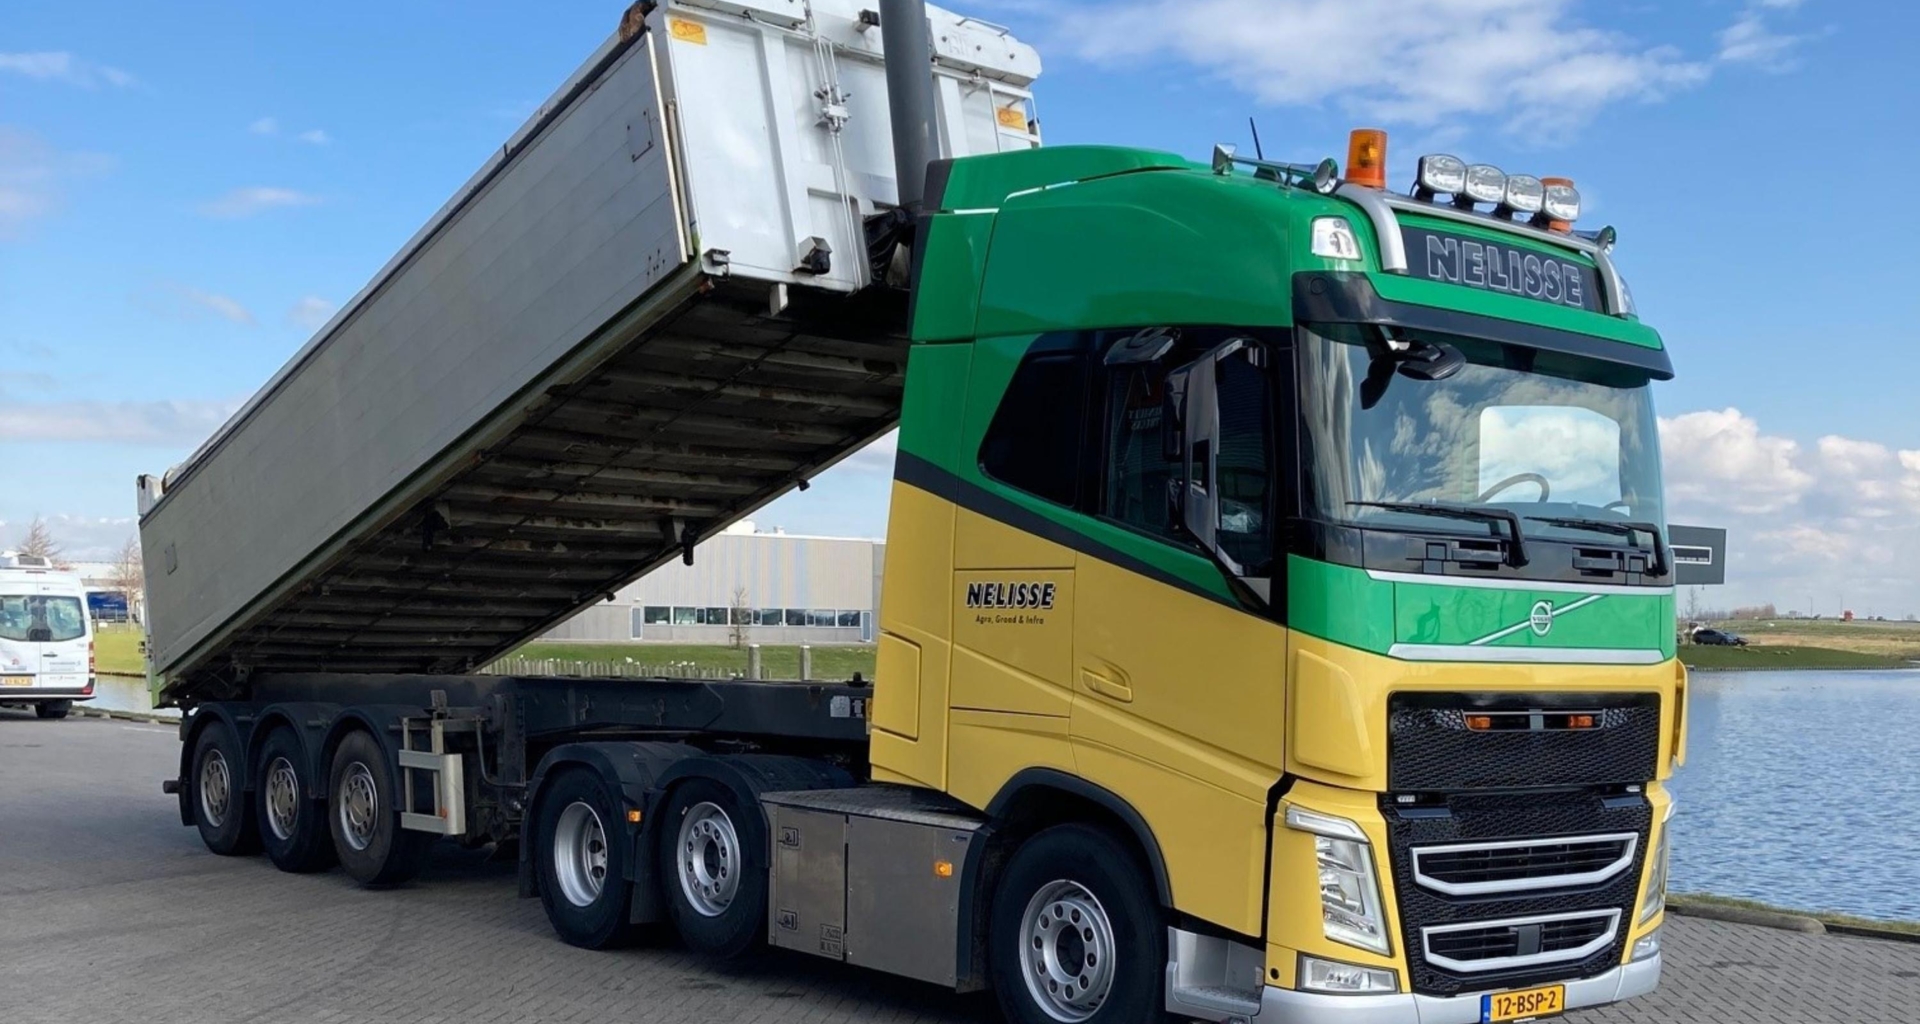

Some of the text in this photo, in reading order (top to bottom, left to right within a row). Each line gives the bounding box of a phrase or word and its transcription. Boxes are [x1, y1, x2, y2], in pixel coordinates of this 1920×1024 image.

[1426, 235, 1582, 306] NELISSE
[967, 582, 1056, 609] NELISSE
[1018, 615, 1024, 624] &
[1496, 990, 1556, 1017] 12-BSP-2
